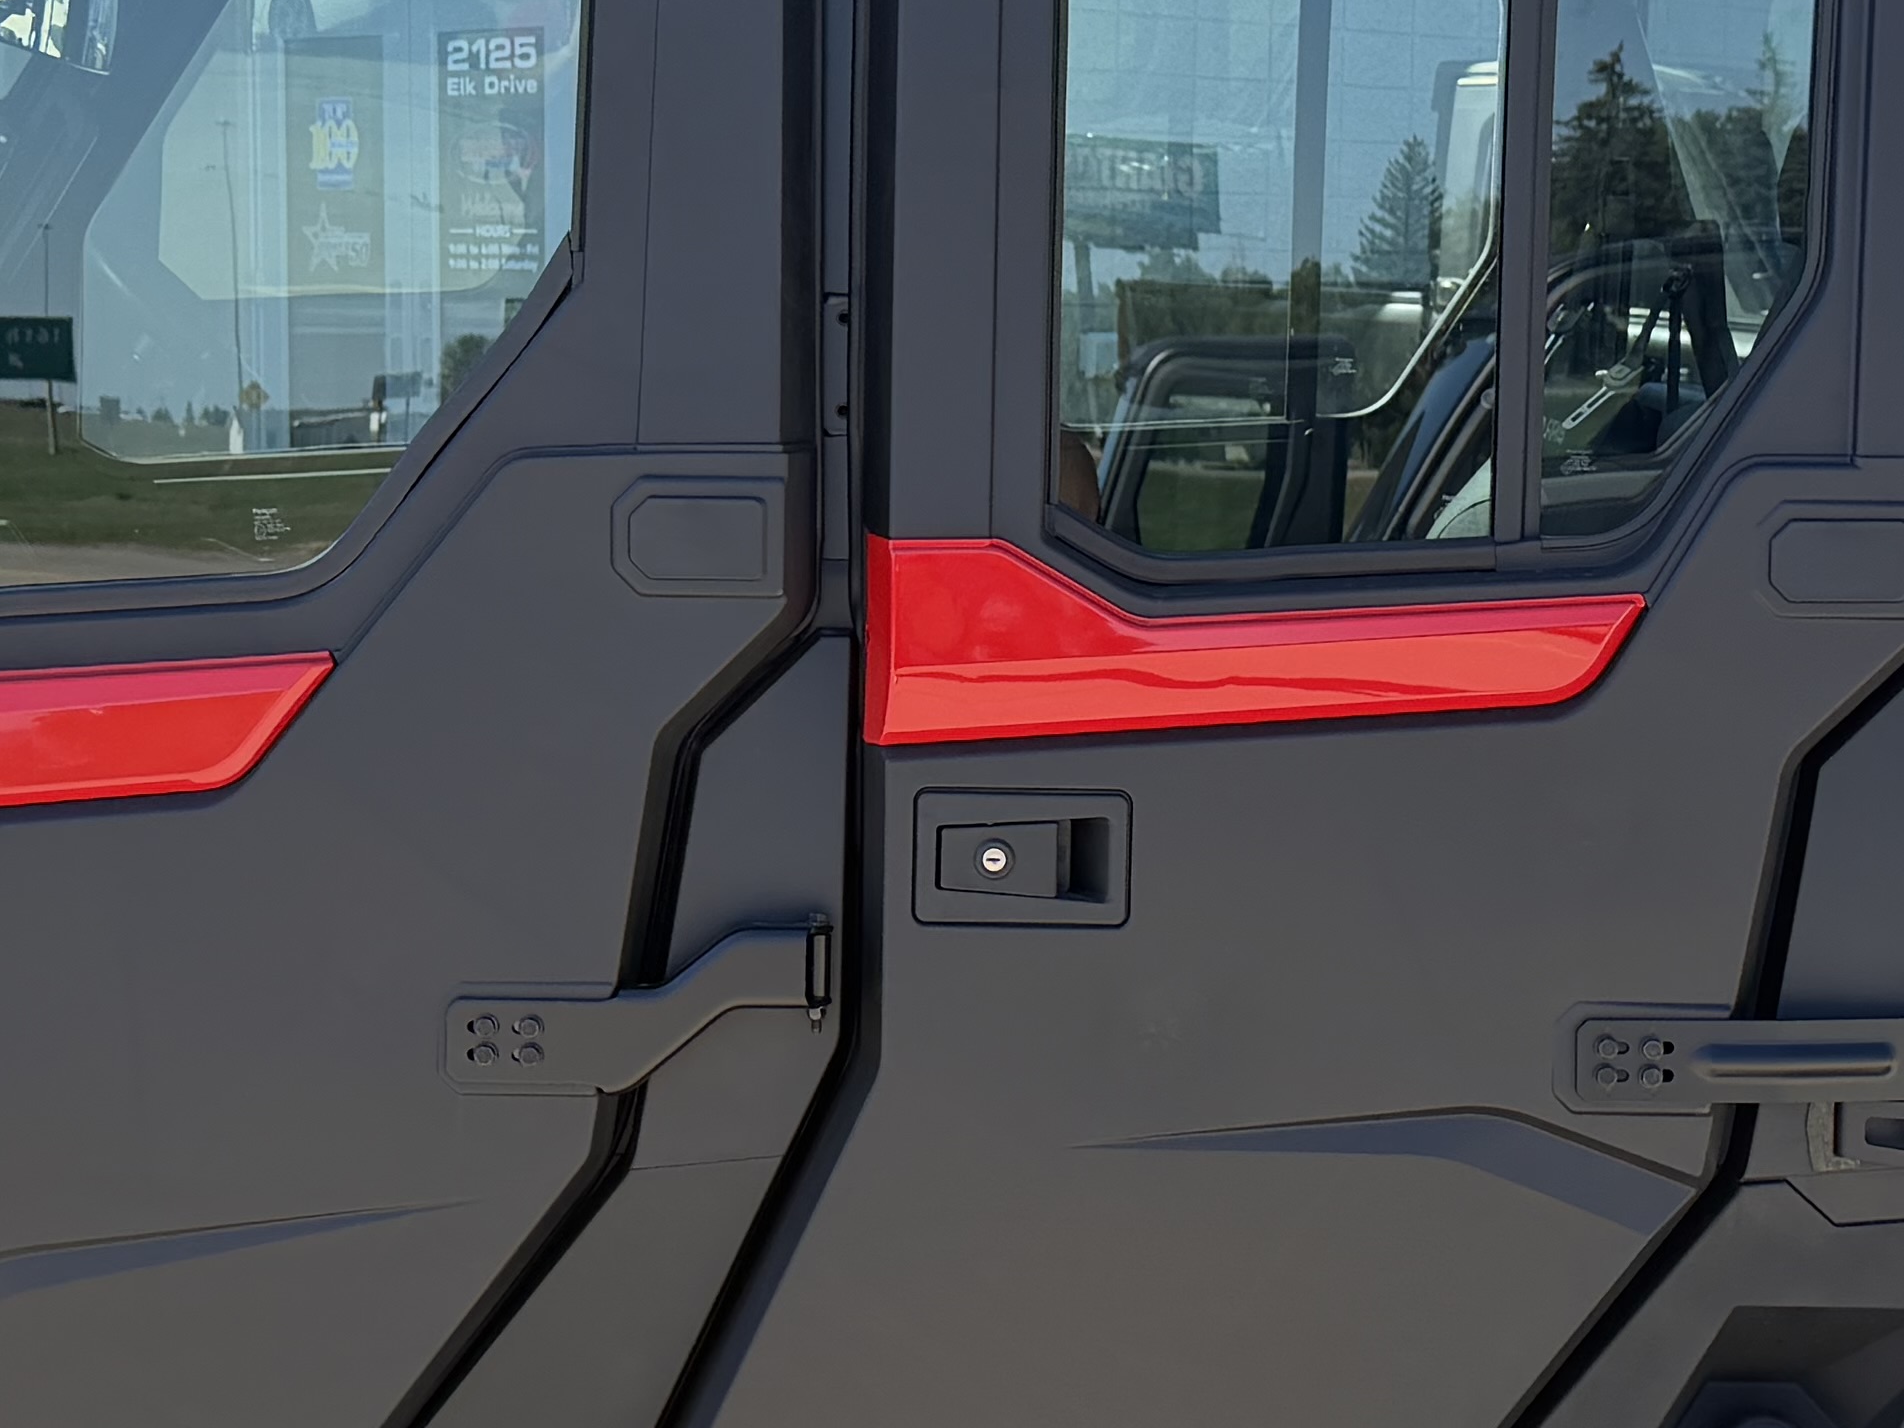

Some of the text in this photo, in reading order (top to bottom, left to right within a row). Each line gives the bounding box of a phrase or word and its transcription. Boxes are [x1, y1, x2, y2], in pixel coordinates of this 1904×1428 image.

[446, 35, 538, 71] 2125
[446, 74, 538, 96] Elk Drive
